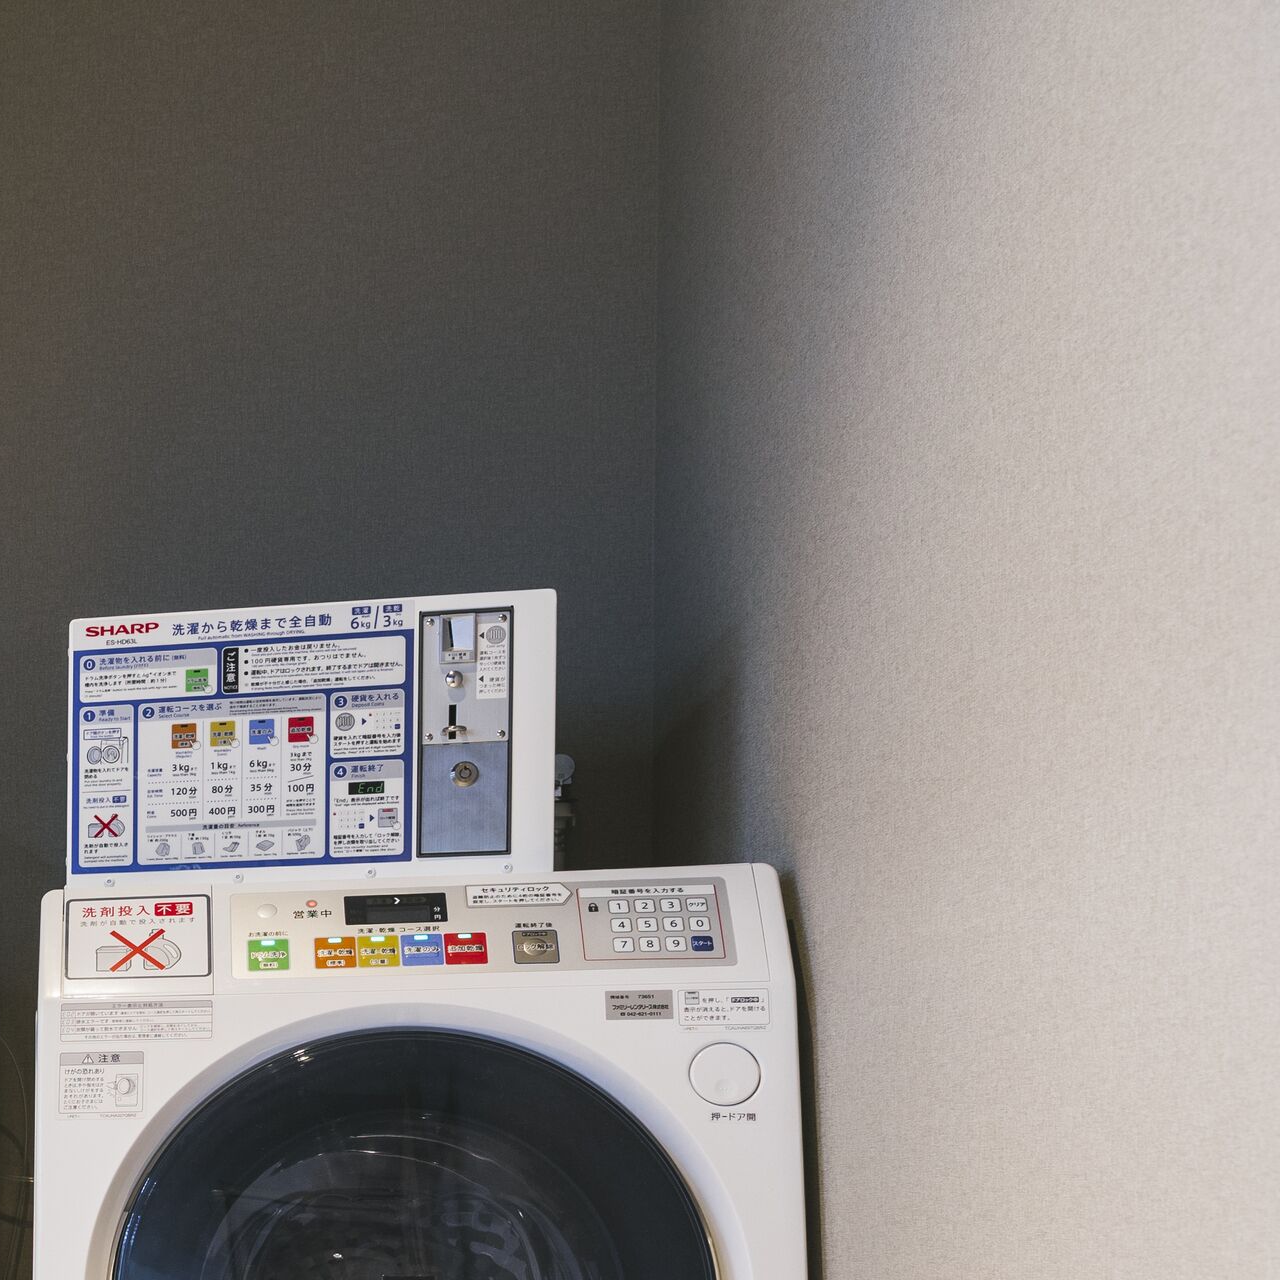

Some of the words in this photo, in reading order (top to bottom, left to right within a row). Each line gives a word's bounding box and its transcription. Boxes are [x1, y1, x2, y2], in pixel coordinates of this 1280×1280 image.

[85, 622, 159, 637] SHARP
[172, 613, 332, 637] 洗濯から乾燥まで全自動
[99, 654, 170, 665] 洗濯物を入れる前に
[226, 652, 236, 683] ご注意
[351, 692, 399, 702] 硬貨を入れる
[158, 702, 222, 713] 運転コースを選ぶ
[290, 763, 312, 772] 30分
[351, 764, 383, 773] 運転終了
[171, 787, 197, 796] 120分
[211, 785, 233, 794] 80分
[250, 783, 273, 792] 35分
[288, 784, 314, 793] 100円
[358, 783, 383, 793] End
[170, 808, 197, 817] 500円
[209, 807, 236, 815] 400円
[247, 804, 275, 814] 300円
[481, 885, 549, 893] セキュリティロック
[82, 905, 150, 918] 洗剤投入
[157, 902, 191, 915] 不要
[293, 909, 332, 919] 営業中
[80, 917, 195, 927] 洗剤が自動で投入されます
[98, 1053, 121, 1063] 注意
